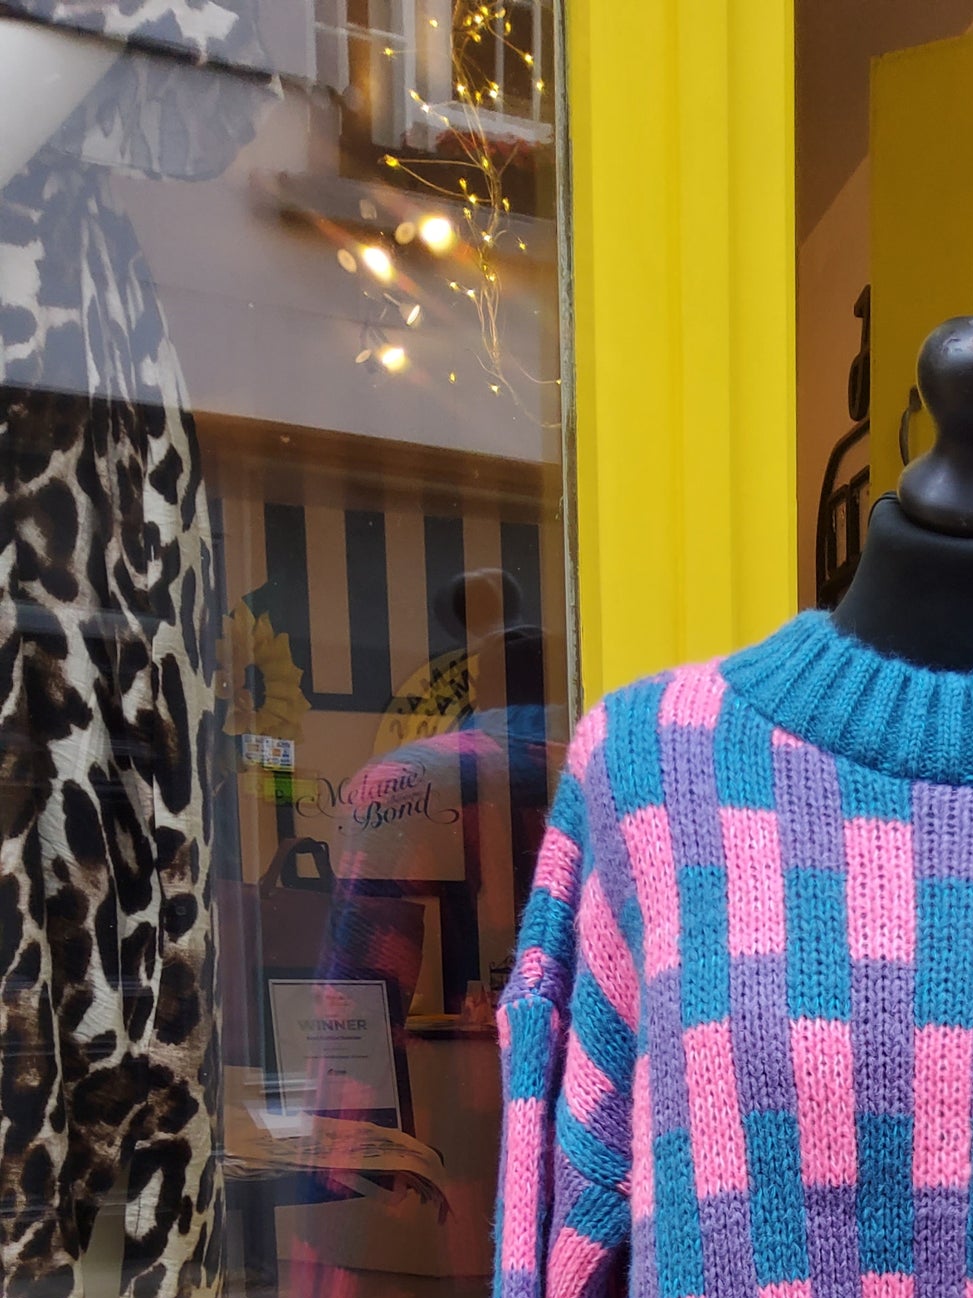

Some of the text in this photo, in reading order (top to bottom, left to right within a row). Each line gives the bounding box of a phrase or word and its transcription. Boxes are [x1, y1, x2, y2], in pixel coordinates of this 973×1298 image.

[296, 760, 425, 819] Melanie
[353, 783, 459, 830] Bond
[296, 1019, 368, 1032] WINNER
